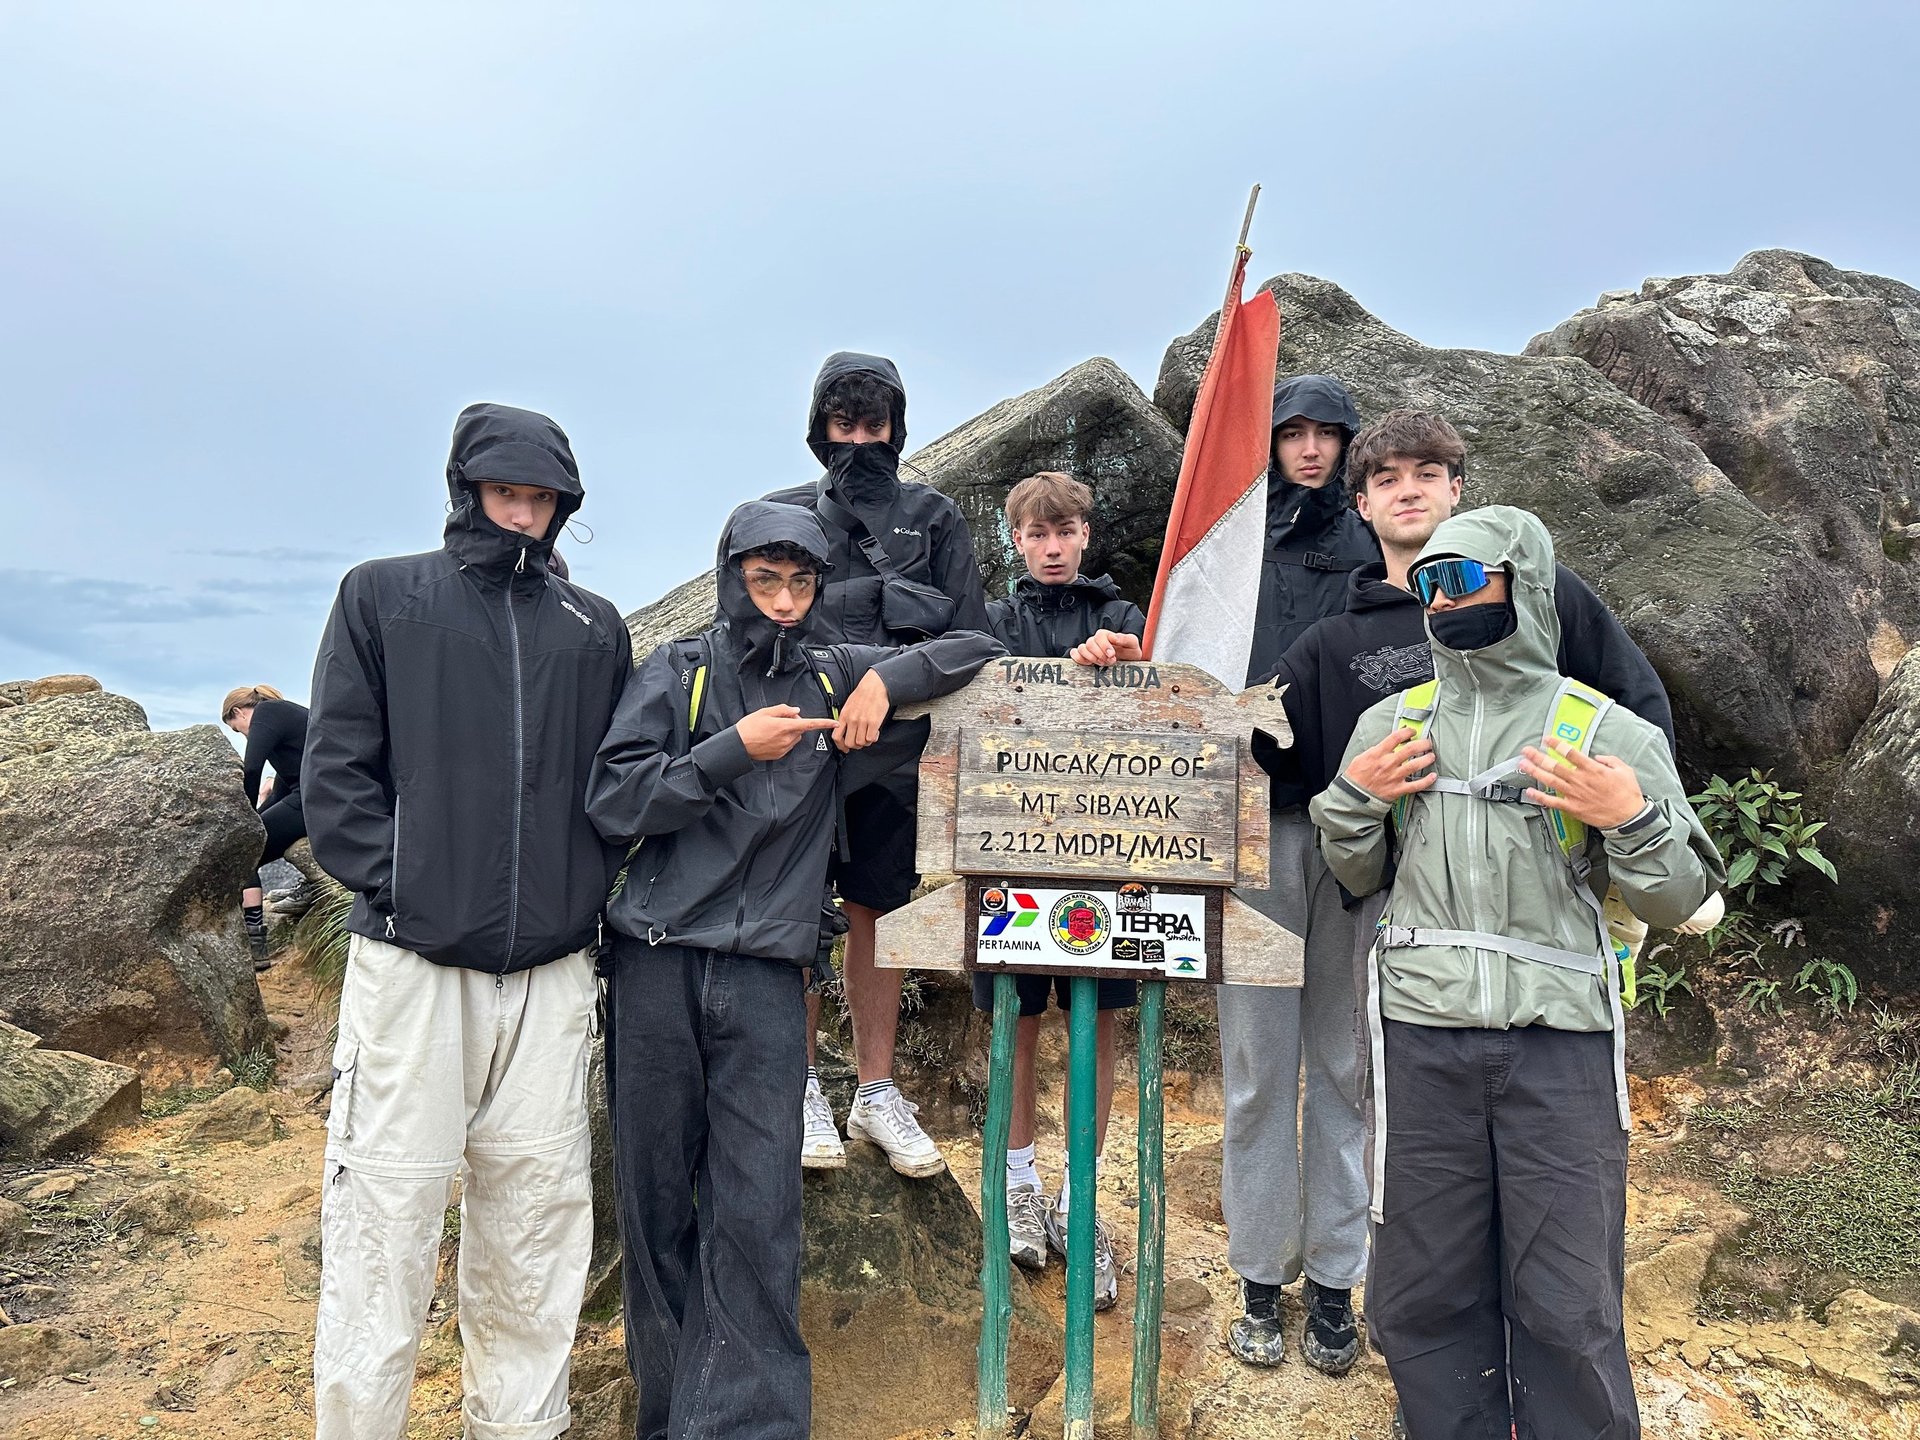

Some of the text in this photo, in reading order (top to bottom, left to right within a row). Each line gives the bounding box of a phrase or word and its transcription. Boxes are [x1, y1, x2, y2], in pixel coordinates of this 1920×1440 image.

[999, 658, 1161, 689] TAKAL KUDA
[996, 751, 1205, 779] PUNCAK/TOP OF
[1074, 793, 1180, 820] SIBAYAK
[979, 830, 1213, 863] 2.212 MDPL/MASL
[1116, 911, 1195, 934] TERRA
[979, 940, 1041, 951] PERTAMINA
[1059, 939, 1101, 953] SUMATERA UTARA
